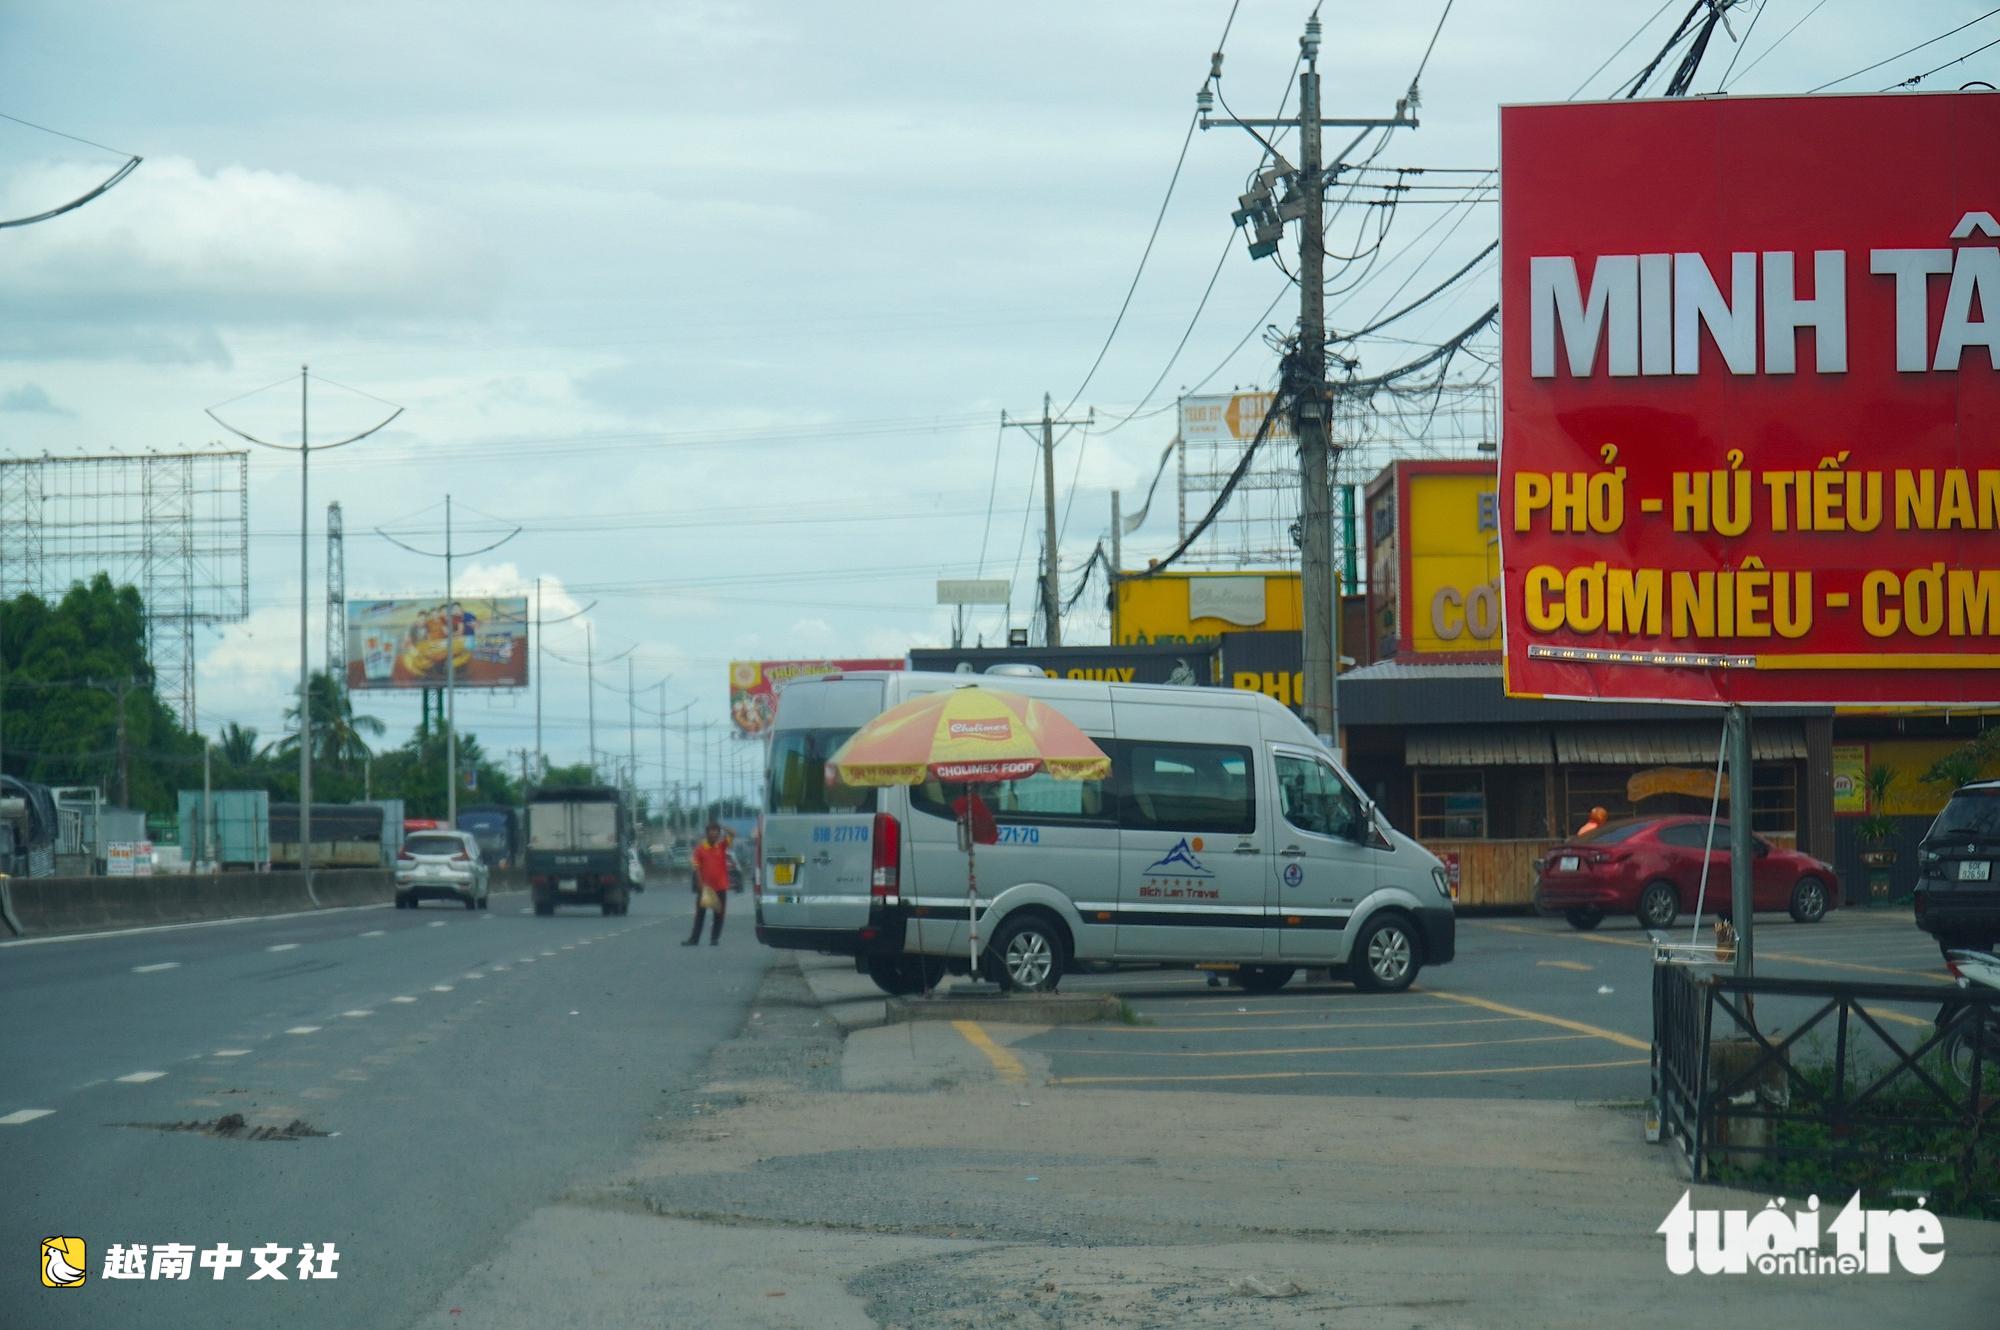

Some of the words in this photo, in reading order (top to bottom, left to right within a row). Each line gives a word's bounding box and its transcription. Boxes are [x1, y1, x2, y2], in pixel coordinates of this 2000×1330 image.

[1530, 250, 1848, 378] MINH
[1514, 443, 1626, 533] PHỞ
[1673, 448, 1752, 536] HỦ
[1762, 450, 1882, 532] TIẾU
[1525, 560, 1663, 634] CƠM
[1671, 555, 1813, 638] NIÊU
[1862, 561, 2000, 638] CƠM
[950, 721, 1009, 733] Cholimex
[936, 763, 997, 777] CHOLIMEX
[1001, 761, 1035, 775] FOOD
[1186, 887, 1219, 899] Travel
